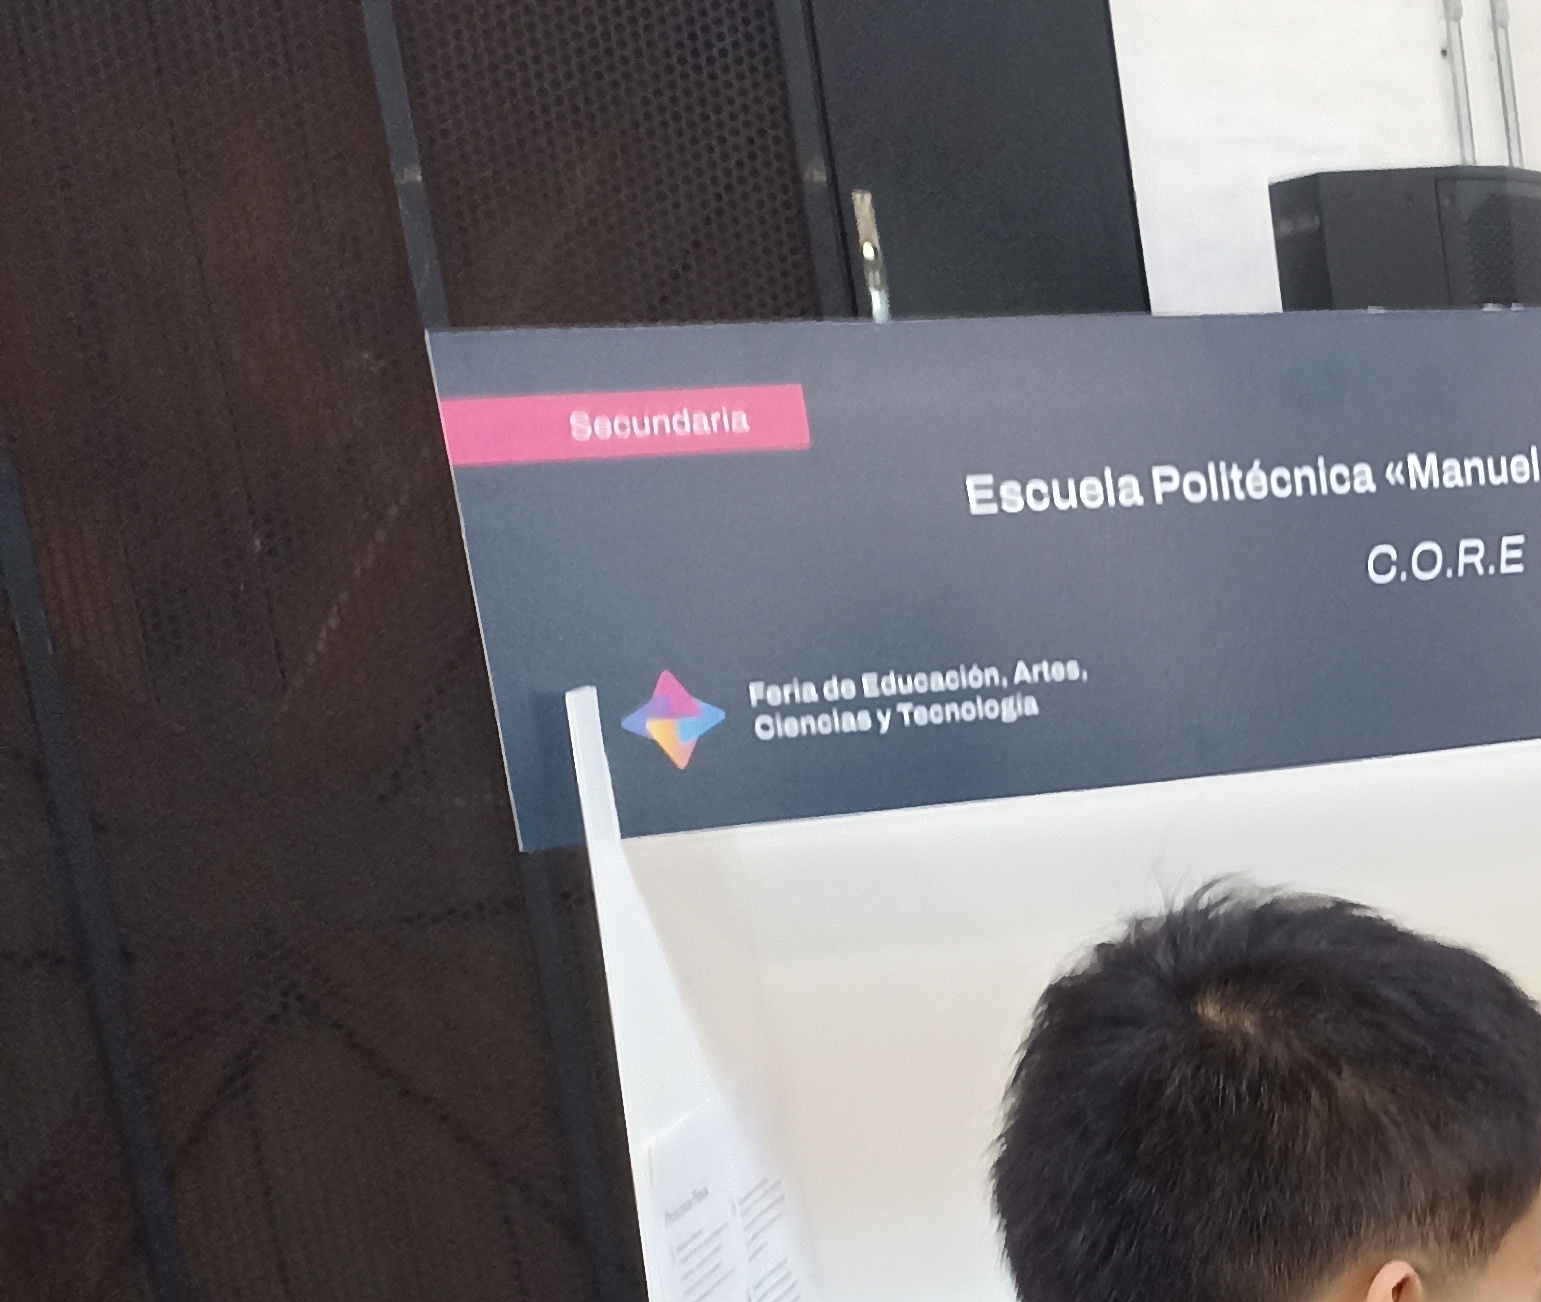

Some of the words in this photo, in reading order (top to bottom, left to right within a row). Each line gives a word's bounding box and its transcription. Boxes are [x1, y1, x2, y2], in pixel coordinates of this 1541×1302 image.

[570, 406, 750, 442] Secundaria
[966, 465, 1144, 515] Escuela
[1151, 455, 1377, 505] Politécnica
[1385, 445, 1540, 490] «Manuel
[1367, 534, 1525, 584] C.O.R.E
[749, 677, 819, 708] Feria
[822, 674, 856, 702] de
[862, 662, 1008, 698] Educación,
[1014, 658, 1088, 685] Artes,
[754, 707, 872, 741] Ciencias
[876, 708, 891, 735] y
[897, 691, 1040, 728] Tecnología
